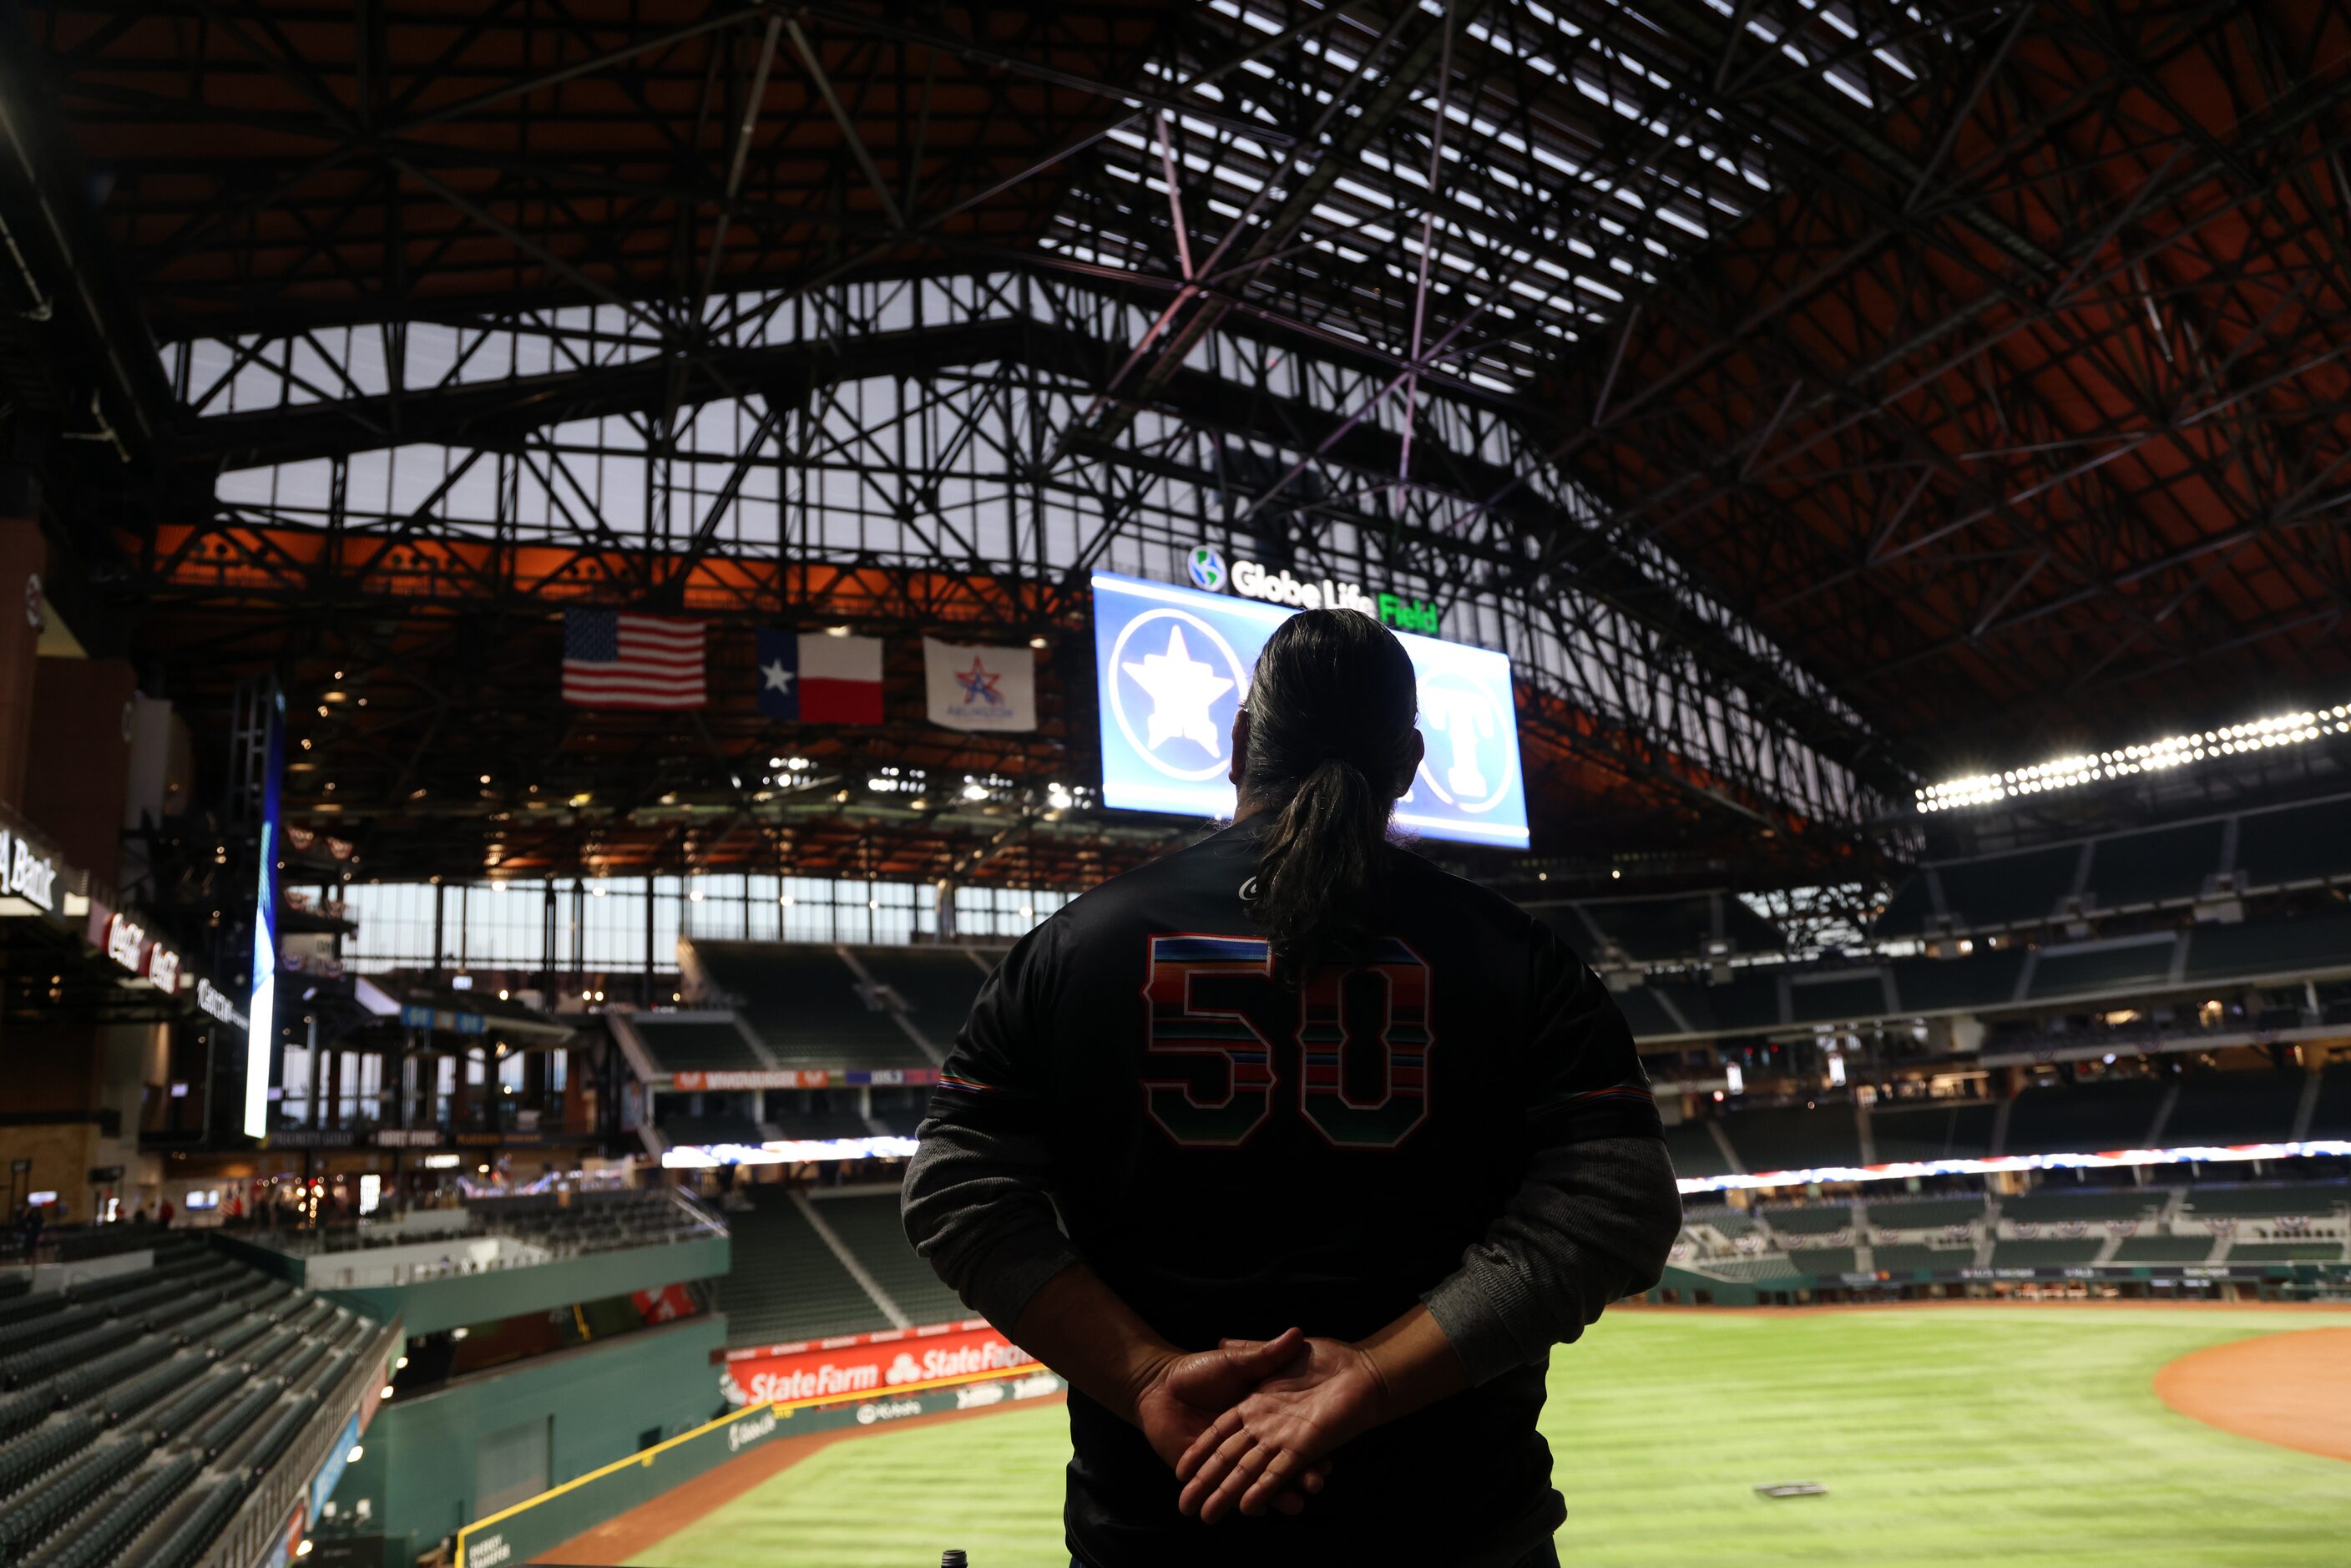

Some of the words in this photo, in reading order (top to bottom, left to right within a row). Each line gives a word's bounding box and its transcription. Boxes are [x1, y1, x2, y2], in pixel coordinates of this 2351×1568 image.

[1231, 559, 1322, 609] Globe
[1322, 579, 1376, 620] Life
[1378, 592, 1438, 634] Field
[10, 837, 56, 911] Bank
[1138, 932, 1436, 1149] 50
